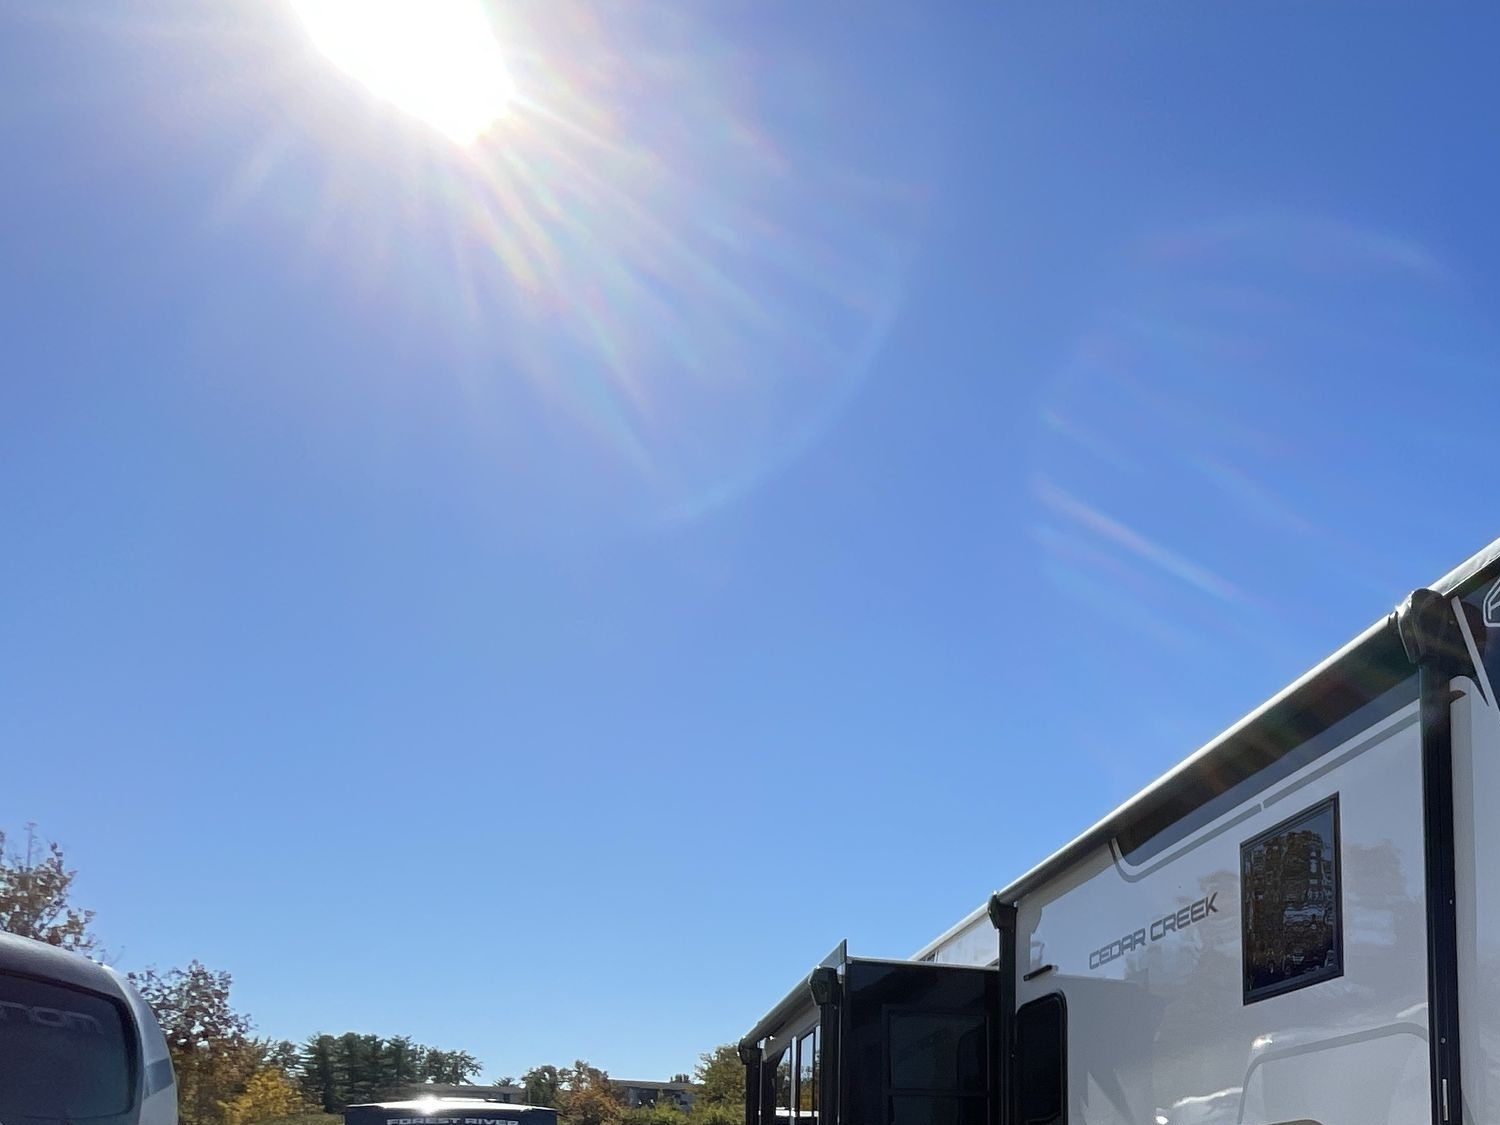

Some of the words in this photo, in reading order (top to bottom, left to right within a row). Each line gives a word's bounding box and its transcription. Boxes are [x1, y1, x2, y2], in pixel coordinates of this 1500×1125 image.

[1089, 928, 1146, 970] CEDAR
[1150, 891, 1219, 941] CREEK
[386, 1117, 461, 1125] FOREST
